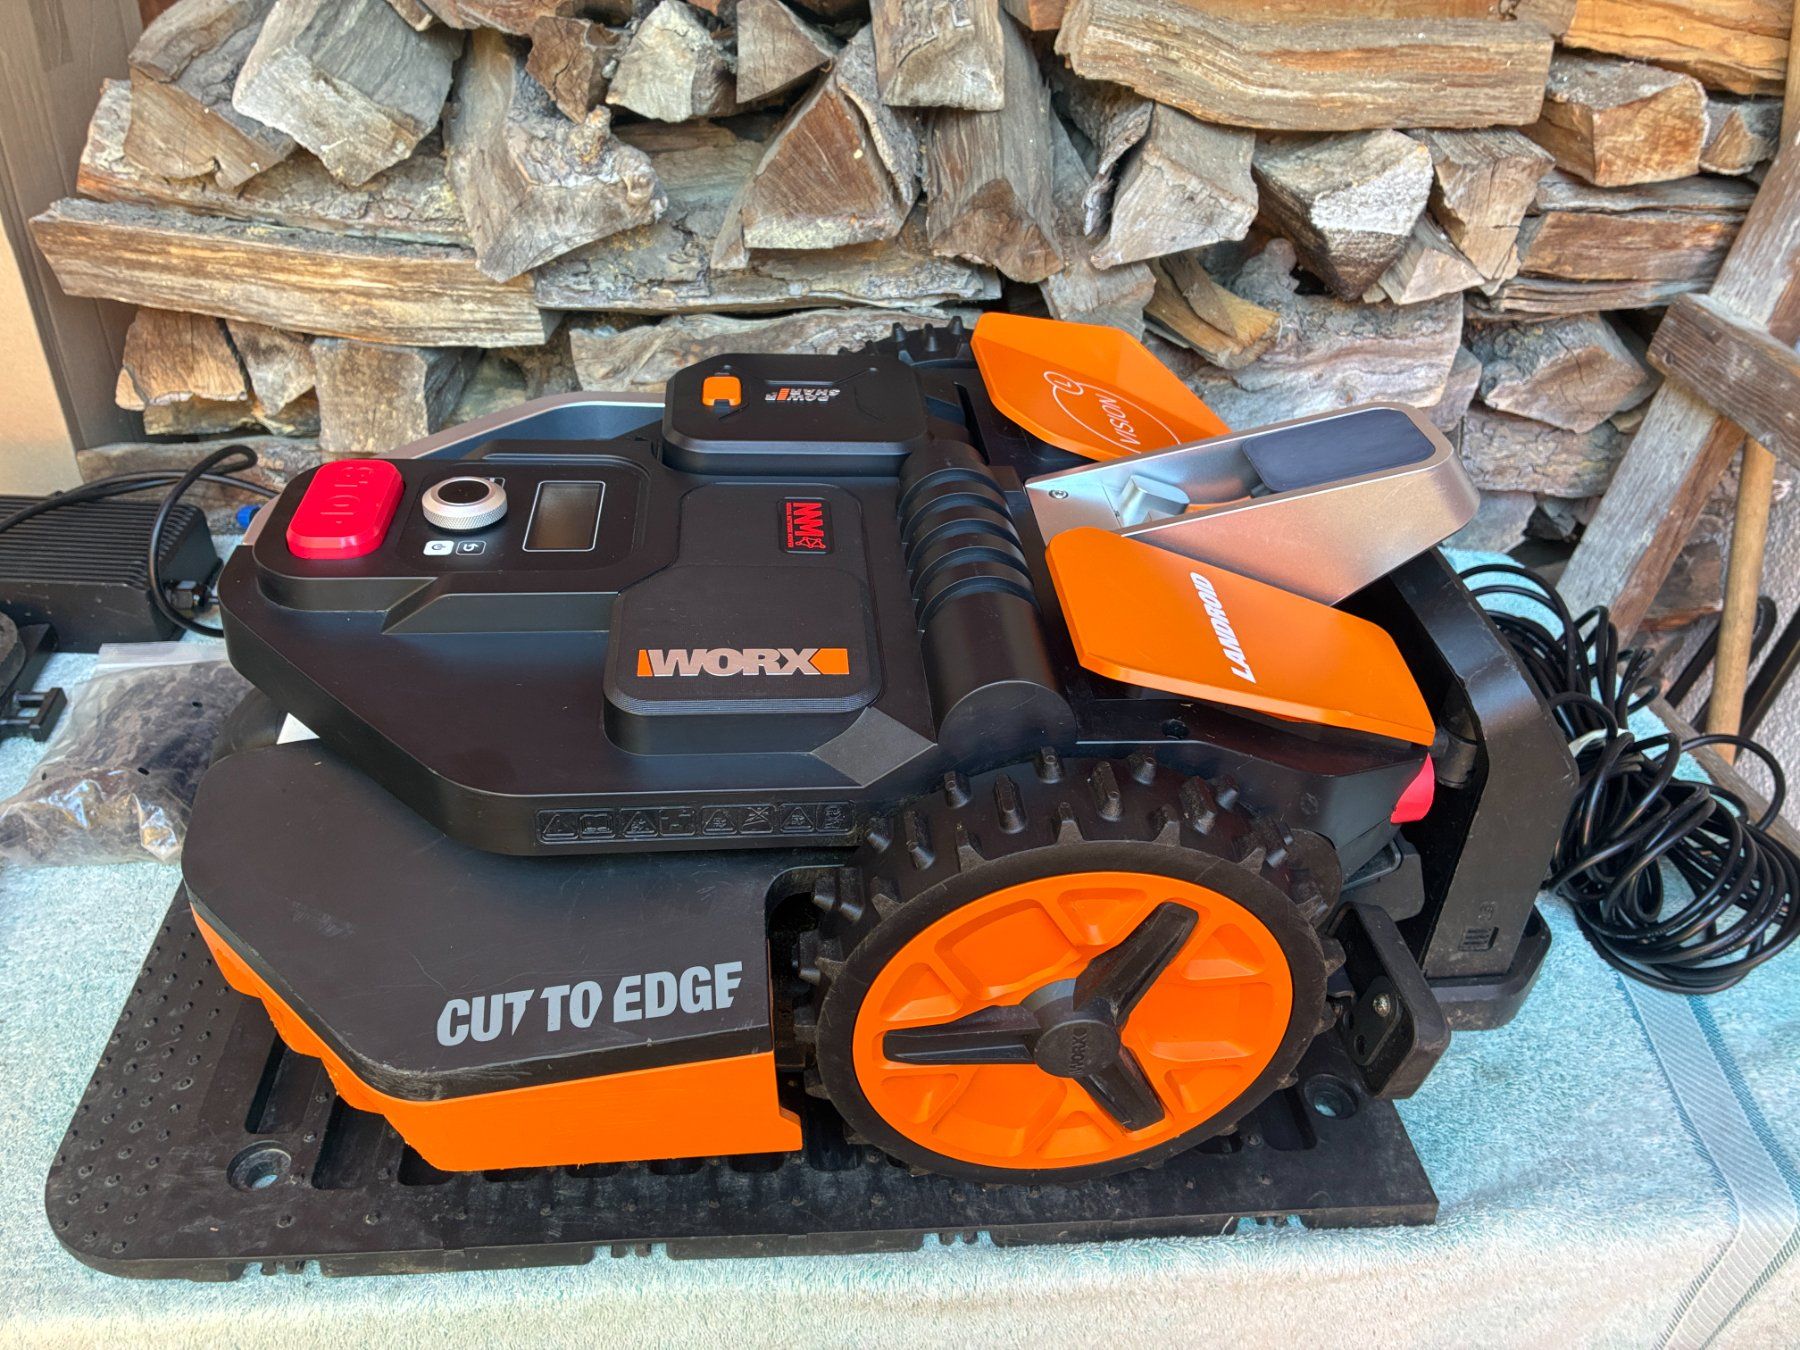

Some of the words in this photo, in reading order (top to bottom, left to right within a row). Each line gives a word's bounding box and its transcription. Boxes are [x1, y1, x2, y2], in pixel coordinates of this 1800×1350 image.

[1094, 392, 1142, 445] VISION
[648, 647, 822, 677] WORX
[1189, 571, 1257, 684] LANDROID
[436, 988, 536, 1048] CUT
[539, 980, 604, 1033] TO
[612, 960, 744, 1024] EDGE
